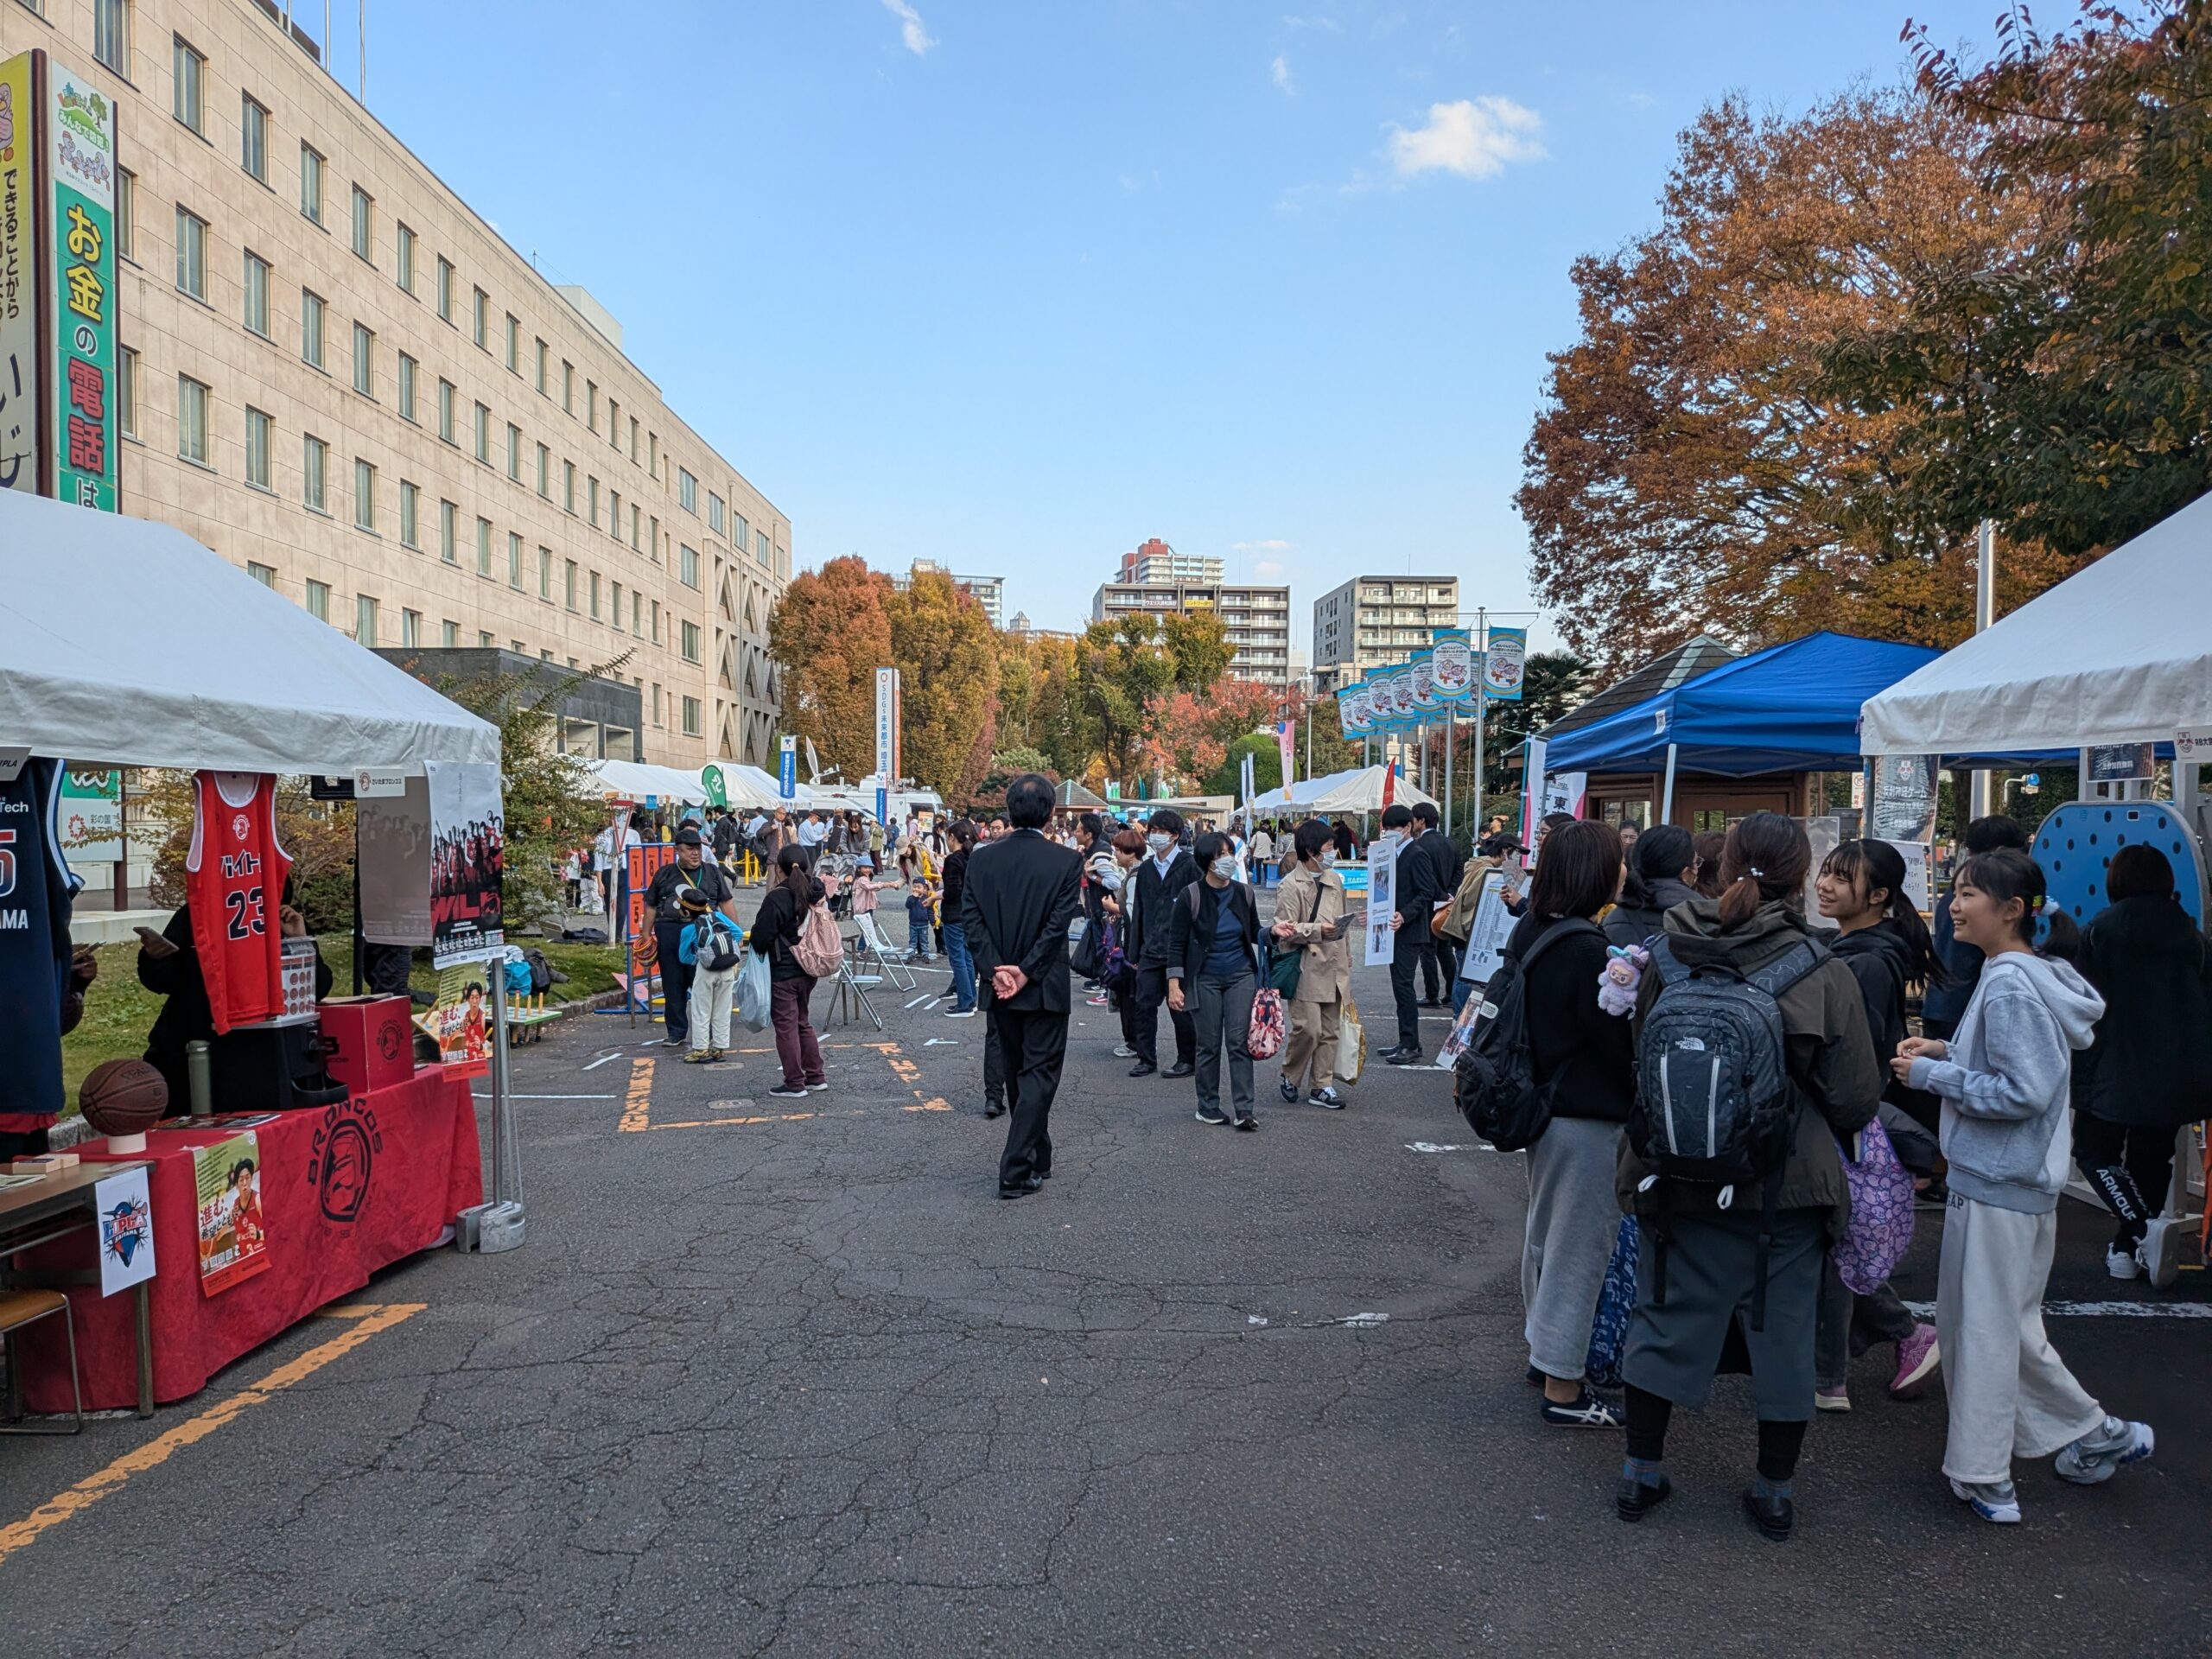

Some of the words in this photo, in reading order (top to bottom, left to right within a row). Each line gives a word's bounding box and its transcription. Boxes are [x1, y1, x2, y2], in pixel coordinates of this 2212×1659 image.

[4, 168, 20, 320] できることから
[90, 814, 111, 824] 彩の国
[220, 849, 262, 879] バイト
[308, 1098, 384, 1185] BRONCOS
[200, 1198, 229, 1227] 進む、
